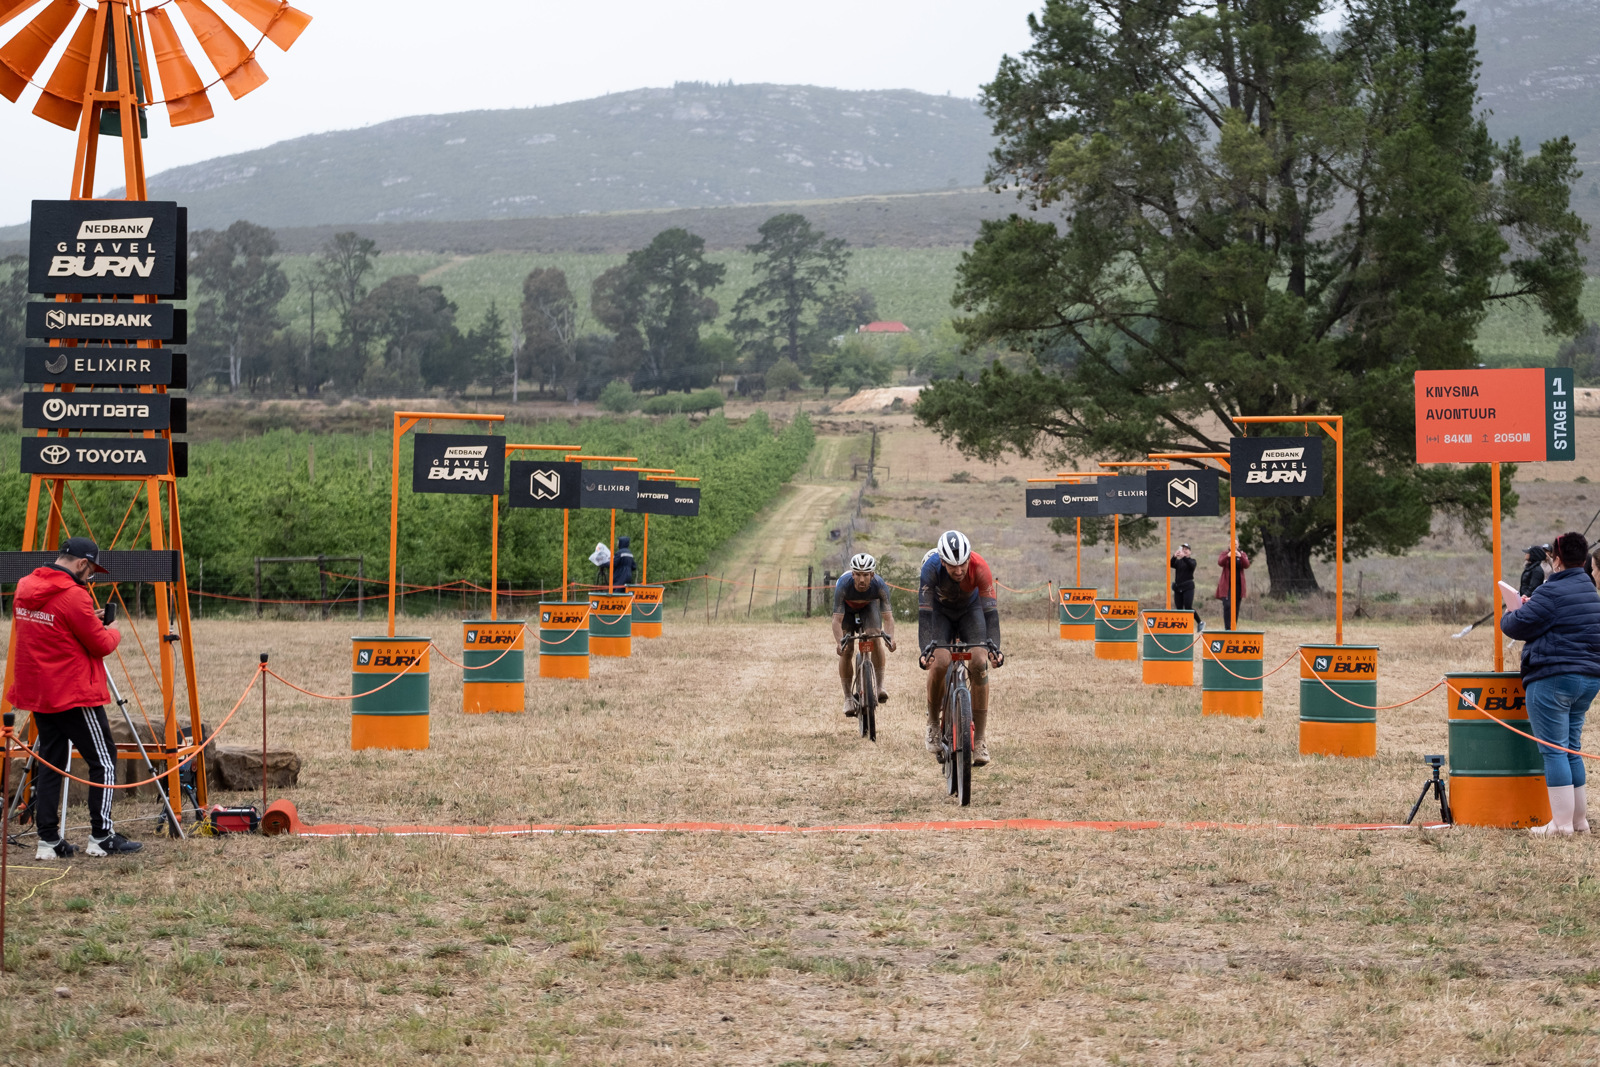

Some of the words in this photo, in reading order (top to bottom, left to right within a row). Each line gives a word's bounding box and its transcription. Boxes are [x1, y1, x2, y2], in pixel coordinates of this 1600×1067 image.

[85, 224, 144, 234] NEDBANK
[57, 242, 156, 254] GRAVEL
[48, 255, 155, 277] BURN
[67, 313, 152, 327] NEDBANK
[74, 358, 151, 372] ELIXIRR
[1426, 386, 1479, 397] KNYSNA
[1552, 377, 1566, 396] 1
[67, 404, 101, 417] NTT
[1426, 408, 1496, 420] AVONTUUR
[1553, 401, 1568, 450] STAGE
[1444, 434, 1472, 444] 84KM
[1494, 433, 1530, 443] 2050M
[76, 448, 147, 463] TOYOTA
[433, 458, 489, 468] GRAVEL
[1250, 462, 1307, 470] GRAVEL
[428, 467, 489, 481] BURN
[1245, 470, 1306, 483] BURN
[598, 484, 630, 492] ELIXIRR
[479, 635, 516, 644] BURN
[1226, 645, 1260, 653] BURN
[374, 655, 421, 666] BURN
[1333, 662, 1375, 673] BURN
[1488, 687, 1520, 695] GRA
[1483, 697, 1526, 710] BUR
